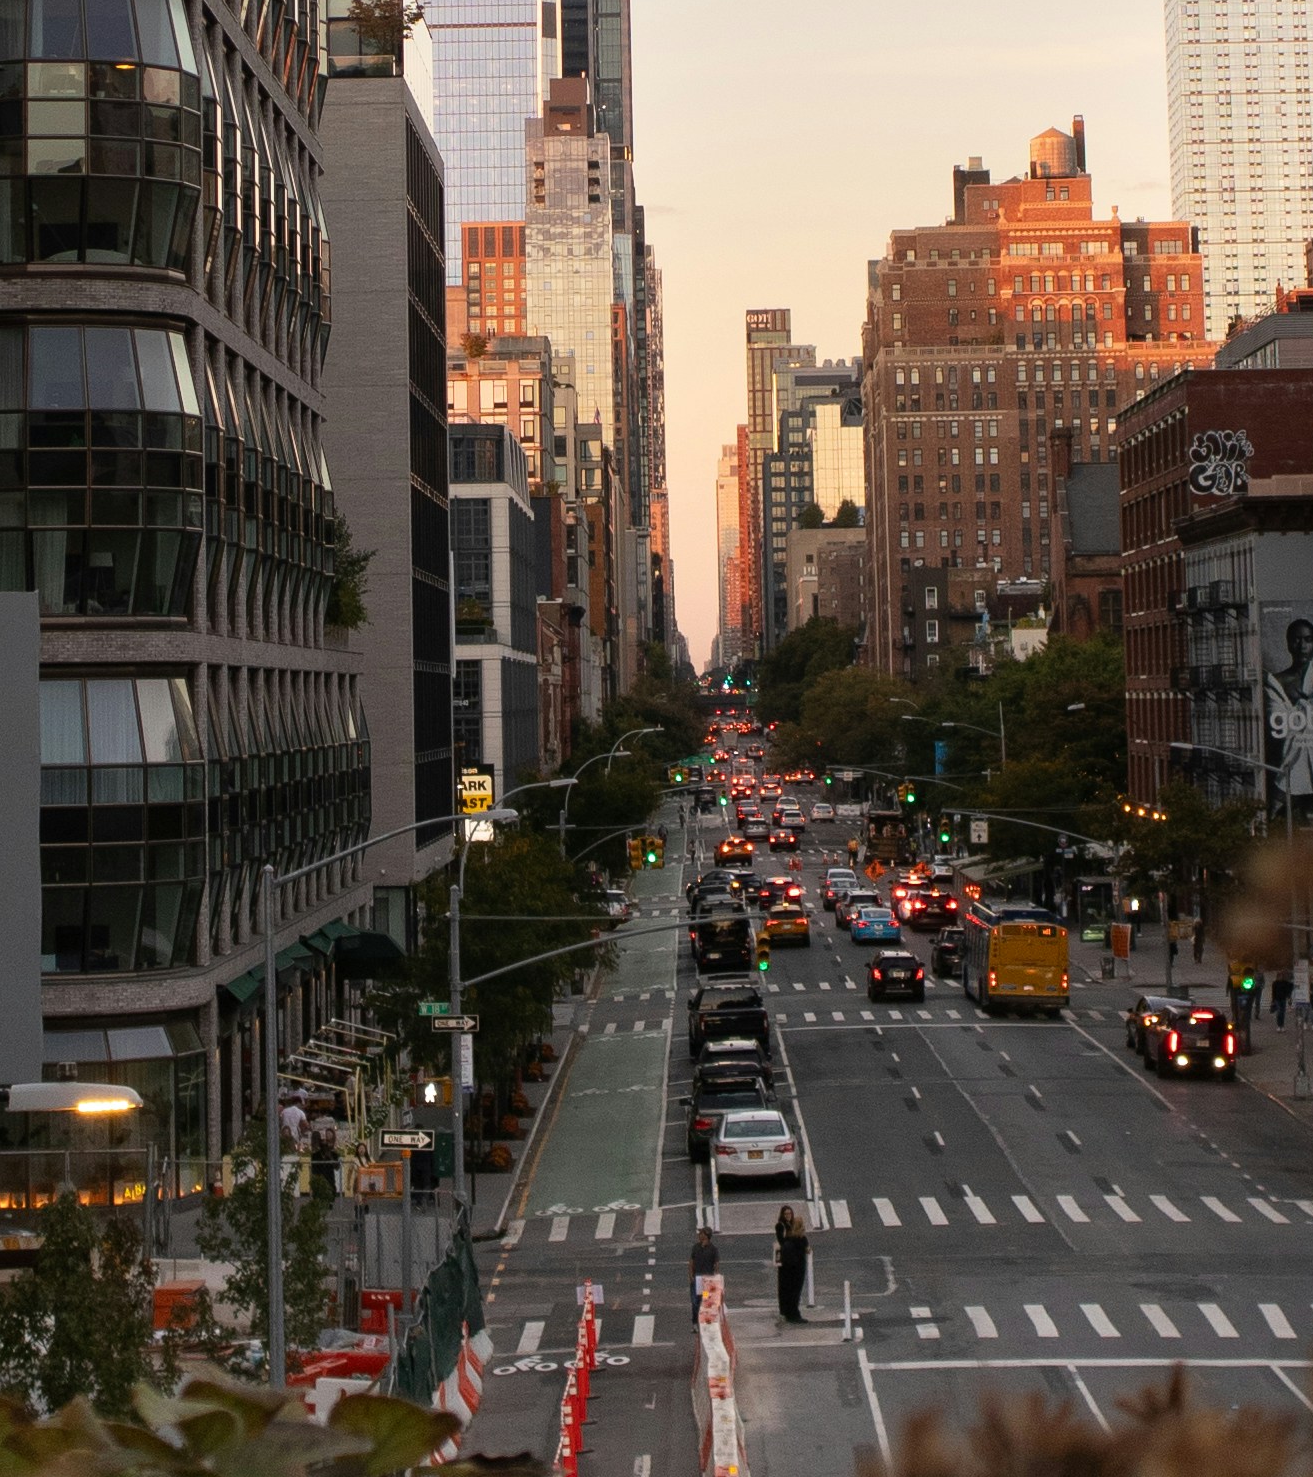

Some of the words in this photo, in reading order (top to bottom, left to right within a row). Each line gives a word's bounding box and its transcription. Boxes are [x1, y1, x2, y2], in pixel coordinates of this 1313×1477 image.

[460, 780, 487, 791] ARK
[461, 797, 487, 809] AST
[388, 1135, 403, 1143] ONE
[410, 1135, 426, 1143] WAY
